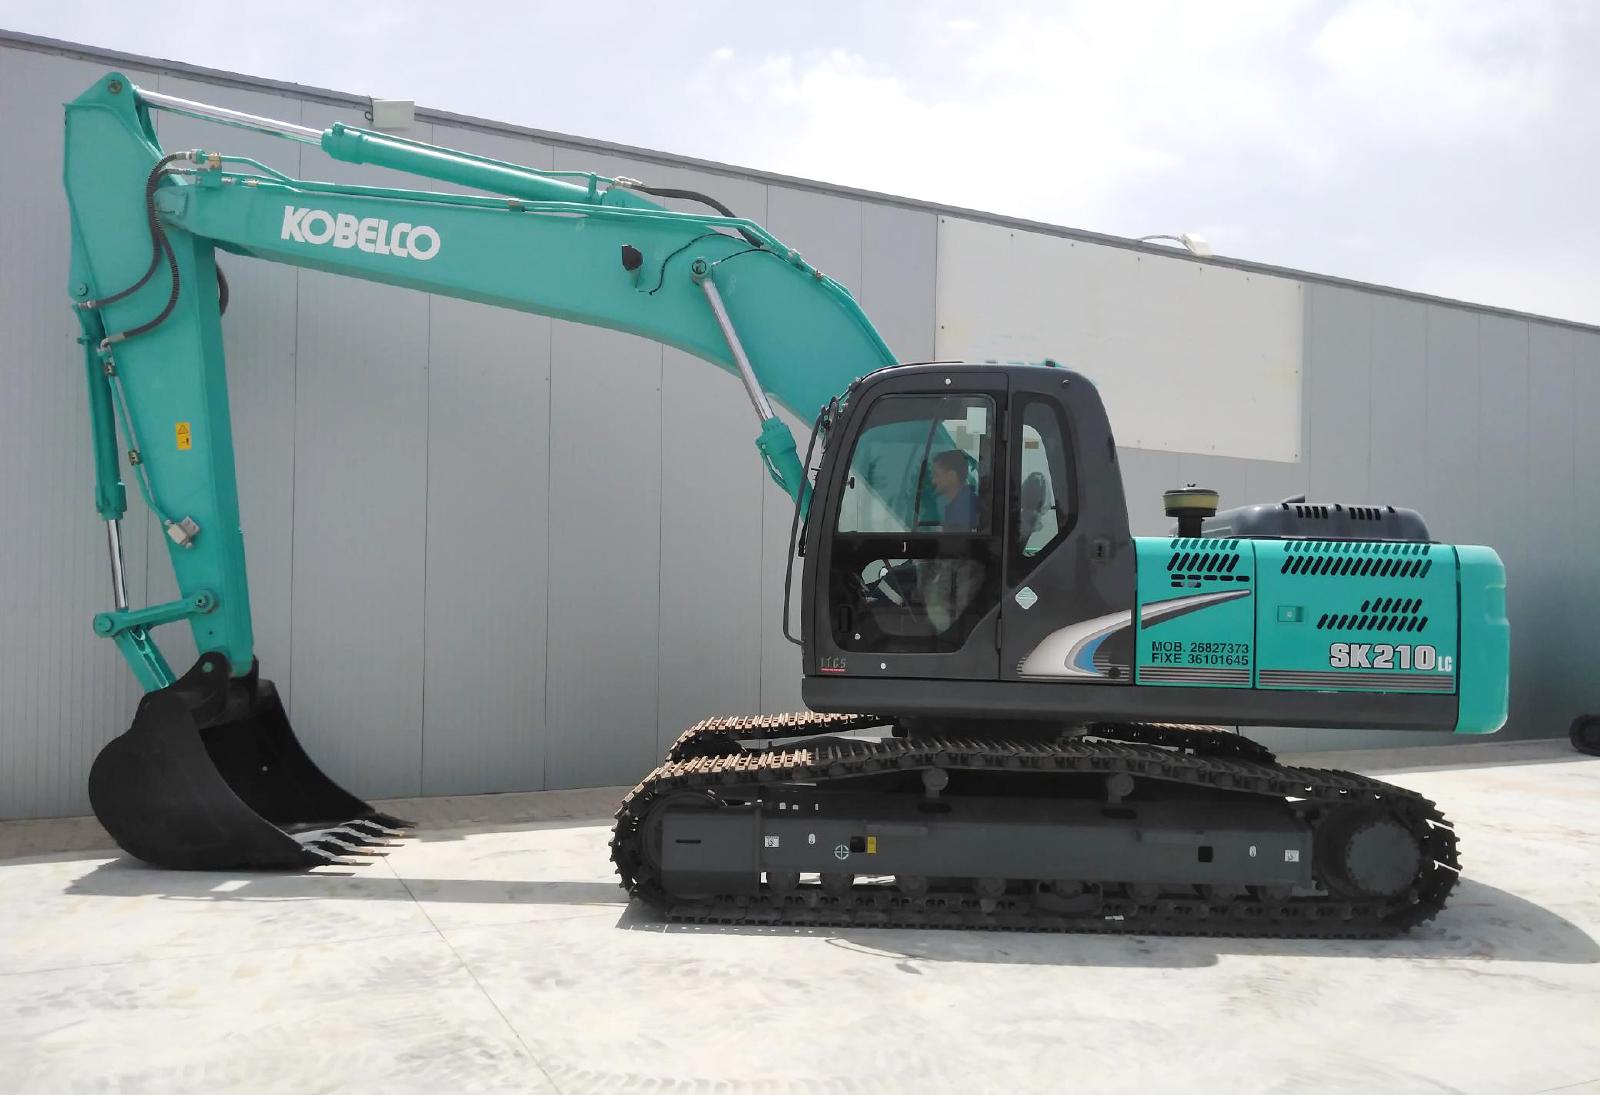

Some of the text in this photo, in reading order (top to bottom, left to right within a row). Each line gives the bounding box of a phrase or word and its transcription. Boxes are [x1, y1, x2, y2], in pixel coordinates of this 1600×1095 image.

[281, 205, 441, 260] KOBELCO
[1152, 641, 1249, 654] MOB. 26827373
[1330, 642, 1453, 672] SK210 LC
[1152, 653, 1249, 665] FIXE 36101645
